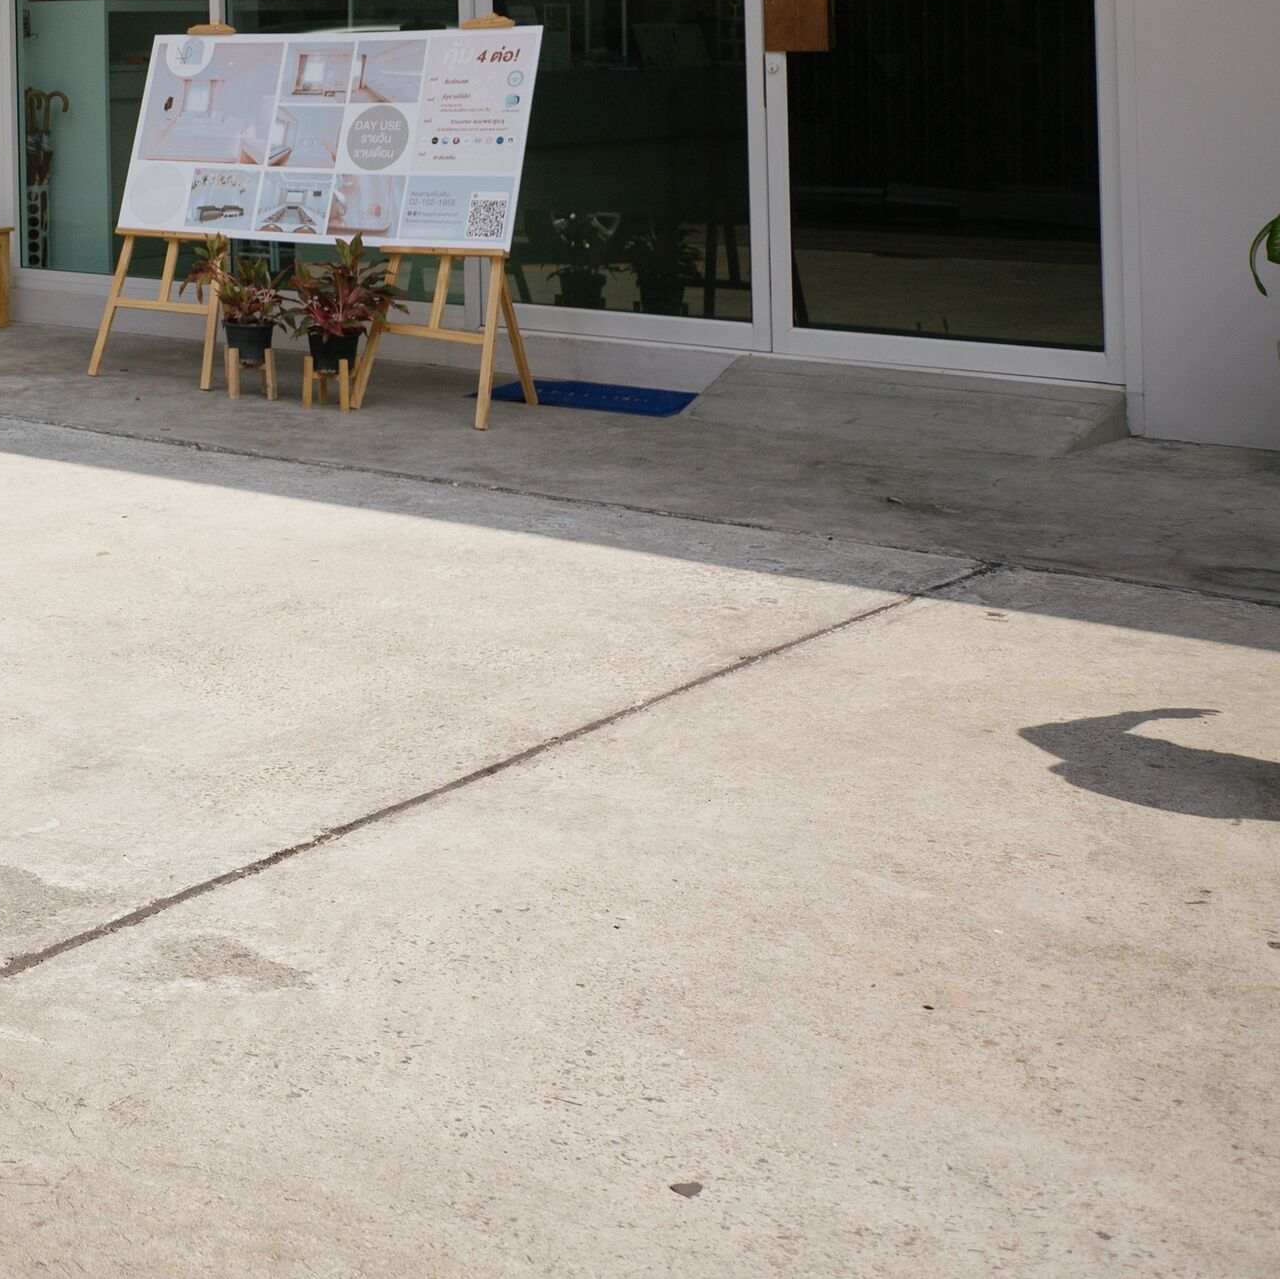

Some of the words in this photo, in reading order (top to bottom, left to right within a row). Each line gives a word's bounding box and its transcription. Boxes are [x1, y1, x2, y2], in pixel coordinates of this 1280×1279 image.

[476, 48, 489, 64] 4
[355, 120, 378, 131] DAY
[380, 120, 402, 131] USE
